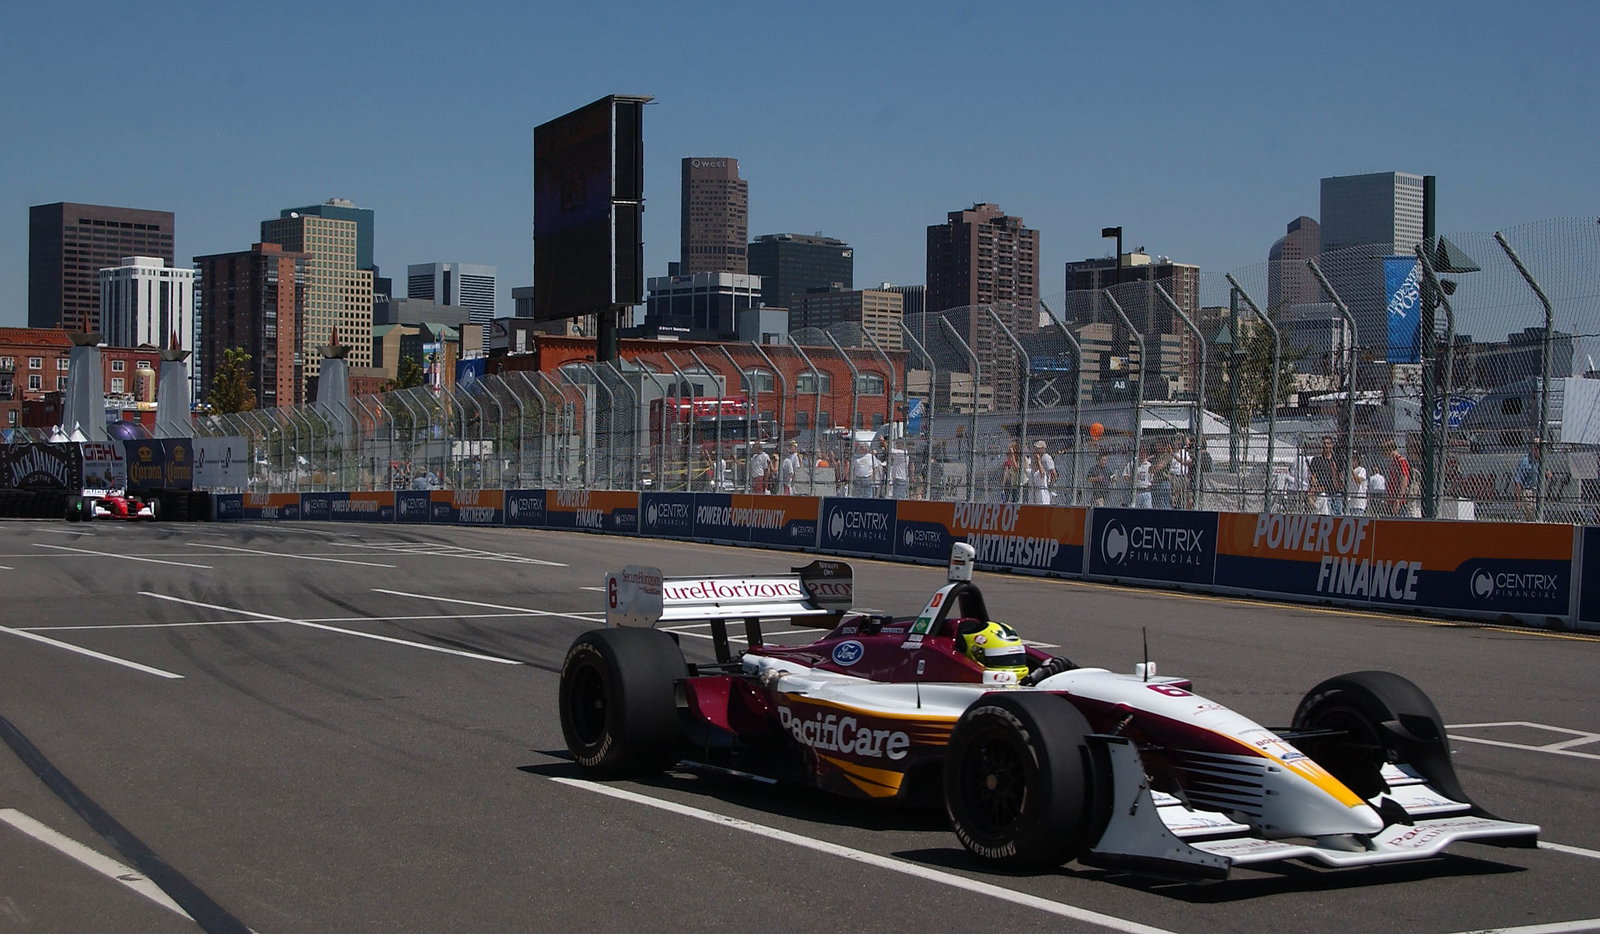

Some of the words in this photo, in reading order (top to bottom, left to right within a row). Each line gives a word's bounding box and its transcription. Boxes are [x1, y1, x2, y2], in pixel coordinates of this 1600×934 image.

[692, 159, 726, 169] Qwest
[1114, 381, 1126, 389] A8
[10, 453, 34, 487] JACK
[32, 445, 70, 487] DANIEL'S
[131, 461, 161, 485] Corona
[454, 489, 473, 504] POWER
[519, 498, 543, 511] CENTRIX
[556, 489, 579, 507] POWER
[579, 490, 590, 507] OF
[459, 506, 495, 523] PARTNERSHIP
[575, 508, 603, 528] FINANCE
[658, 503, 689, 517] CENTRIX
[697, 506, 722, 525] POWER
[722, 507, 732, 526] OF
[731, 507, 786, 530] OPPORTUNITY
[952, 502, 1000, 530] POWER
[1001, 503, 1021, 532] OF
[845, 511, 889, 531] CENTRIX
[844, 530, 887, 541] FINANCIAL
[914, 530, 941, 542] CENTRIX
[1130, 526, 1204, 552] CENTRIX
[1253, 514, 1333, 551] POWER
[1336, 518, 1370, 555] OF
[966, 532, 1059, 568] PARTNERSHIP
[1129, 551, 1201, 566] FINANCIAL
[1316, 557, 1422, 601] FINANCE
[1495, 572, 1557, 590] CENTRIX
[609, 577, 618, 609] 6
[663, 580, 805, 600] ureHorizons
[1495, 589, 1557, 600] FINANCIAL
[837, 643, 858, 660] Ford
[1146, 684, 1194, 697] 6
[778, 705, 911, 761] PacifiCare
